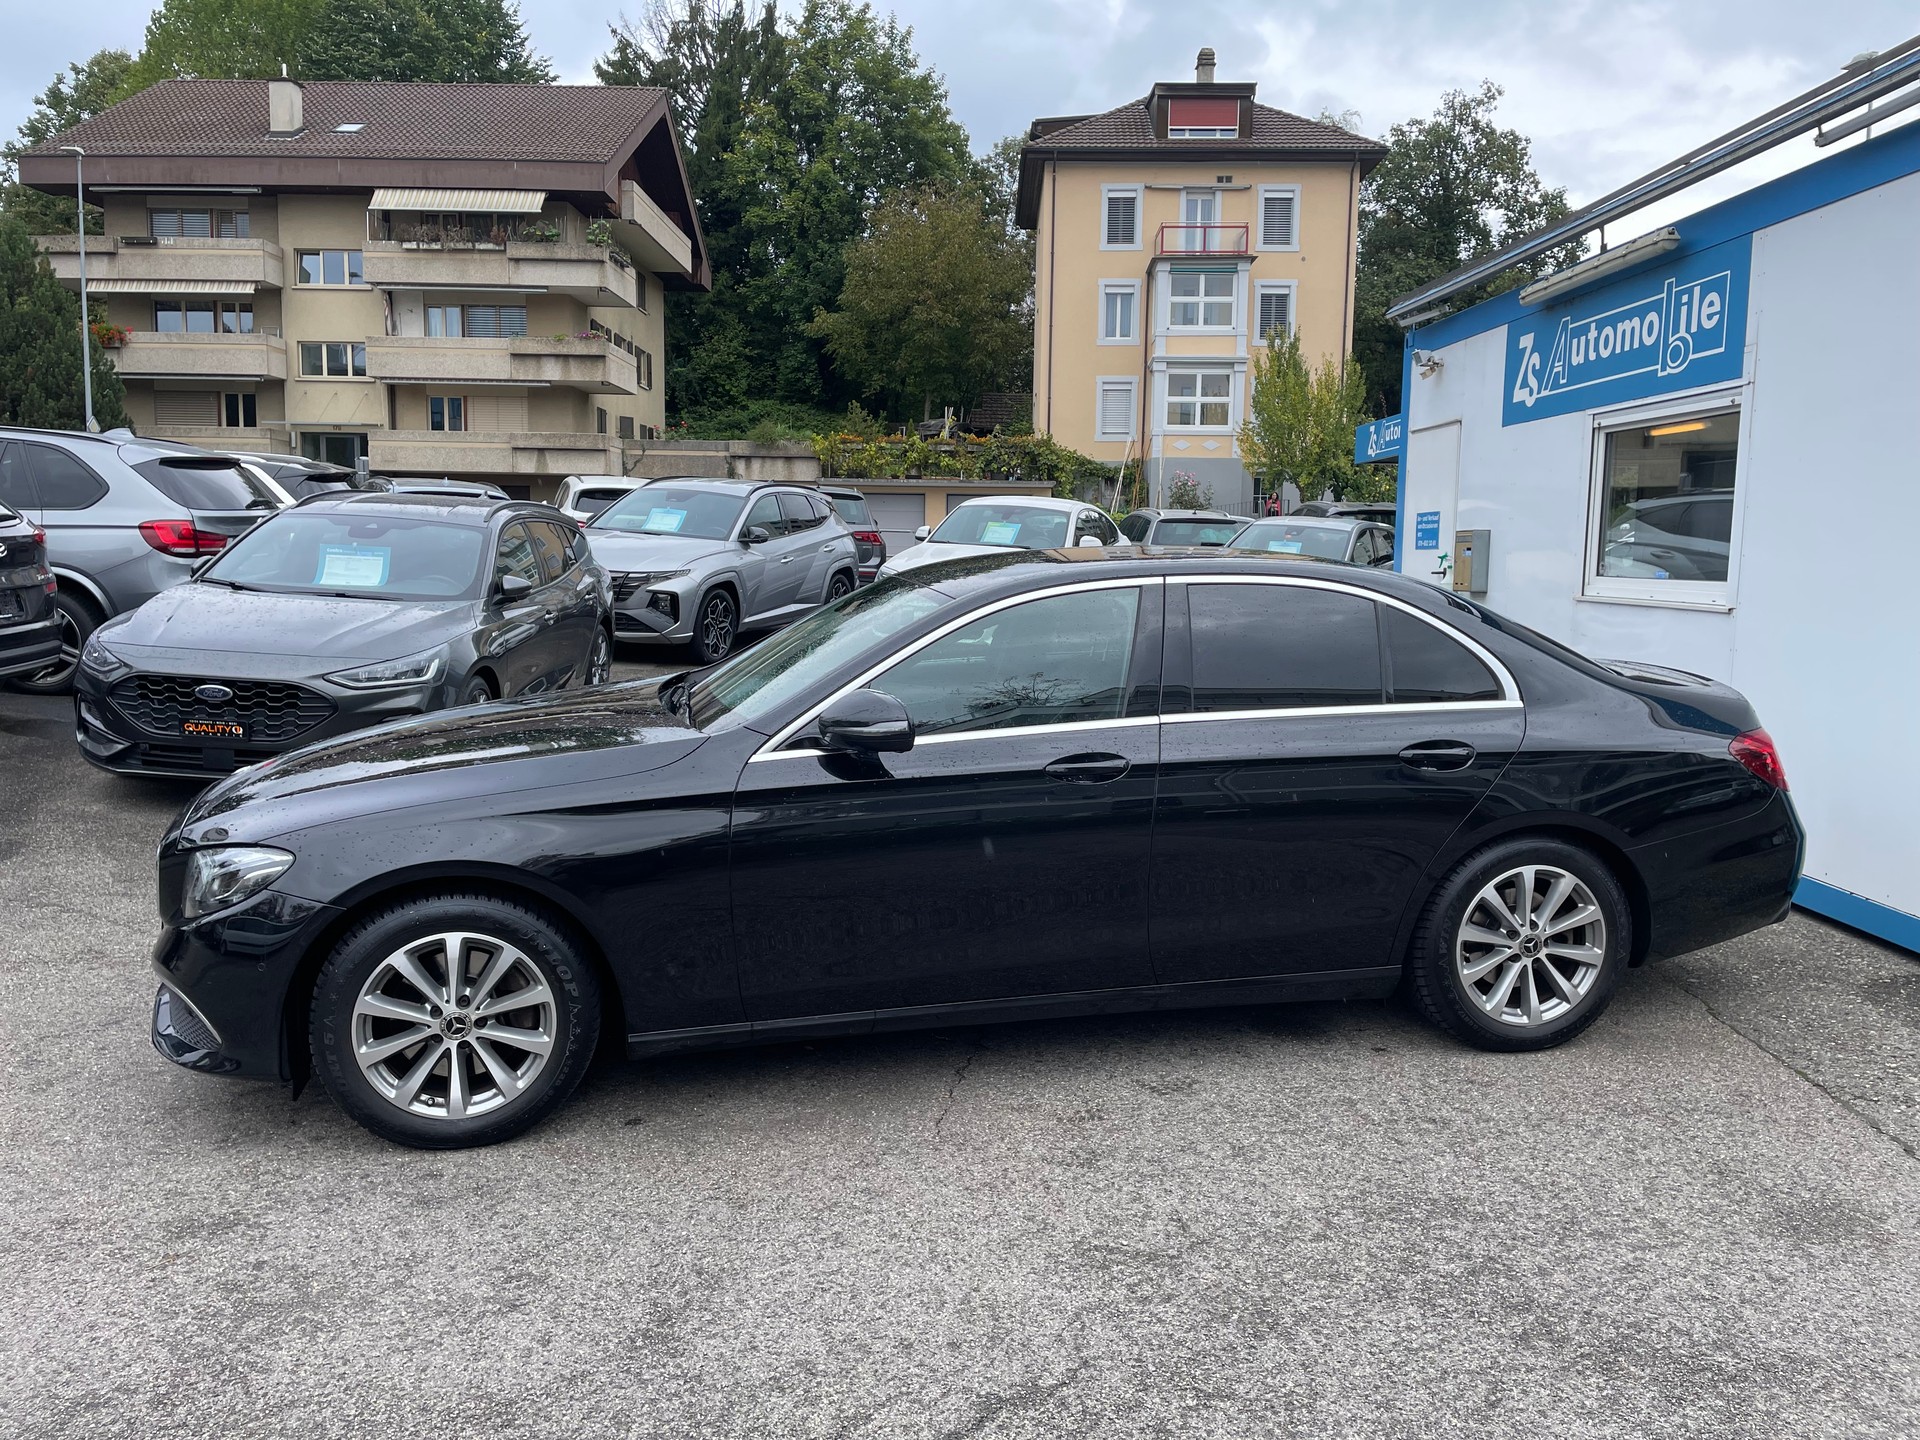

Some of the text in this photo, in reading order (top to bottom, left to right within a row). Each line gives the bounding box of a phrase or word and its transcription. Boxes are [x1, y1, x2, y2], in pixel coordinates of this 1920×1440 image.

[1542, 277, 1722, 377] Automobile
[203, 688, 223, 697] Ford
[184, 723, 231, 733] QUALITY
